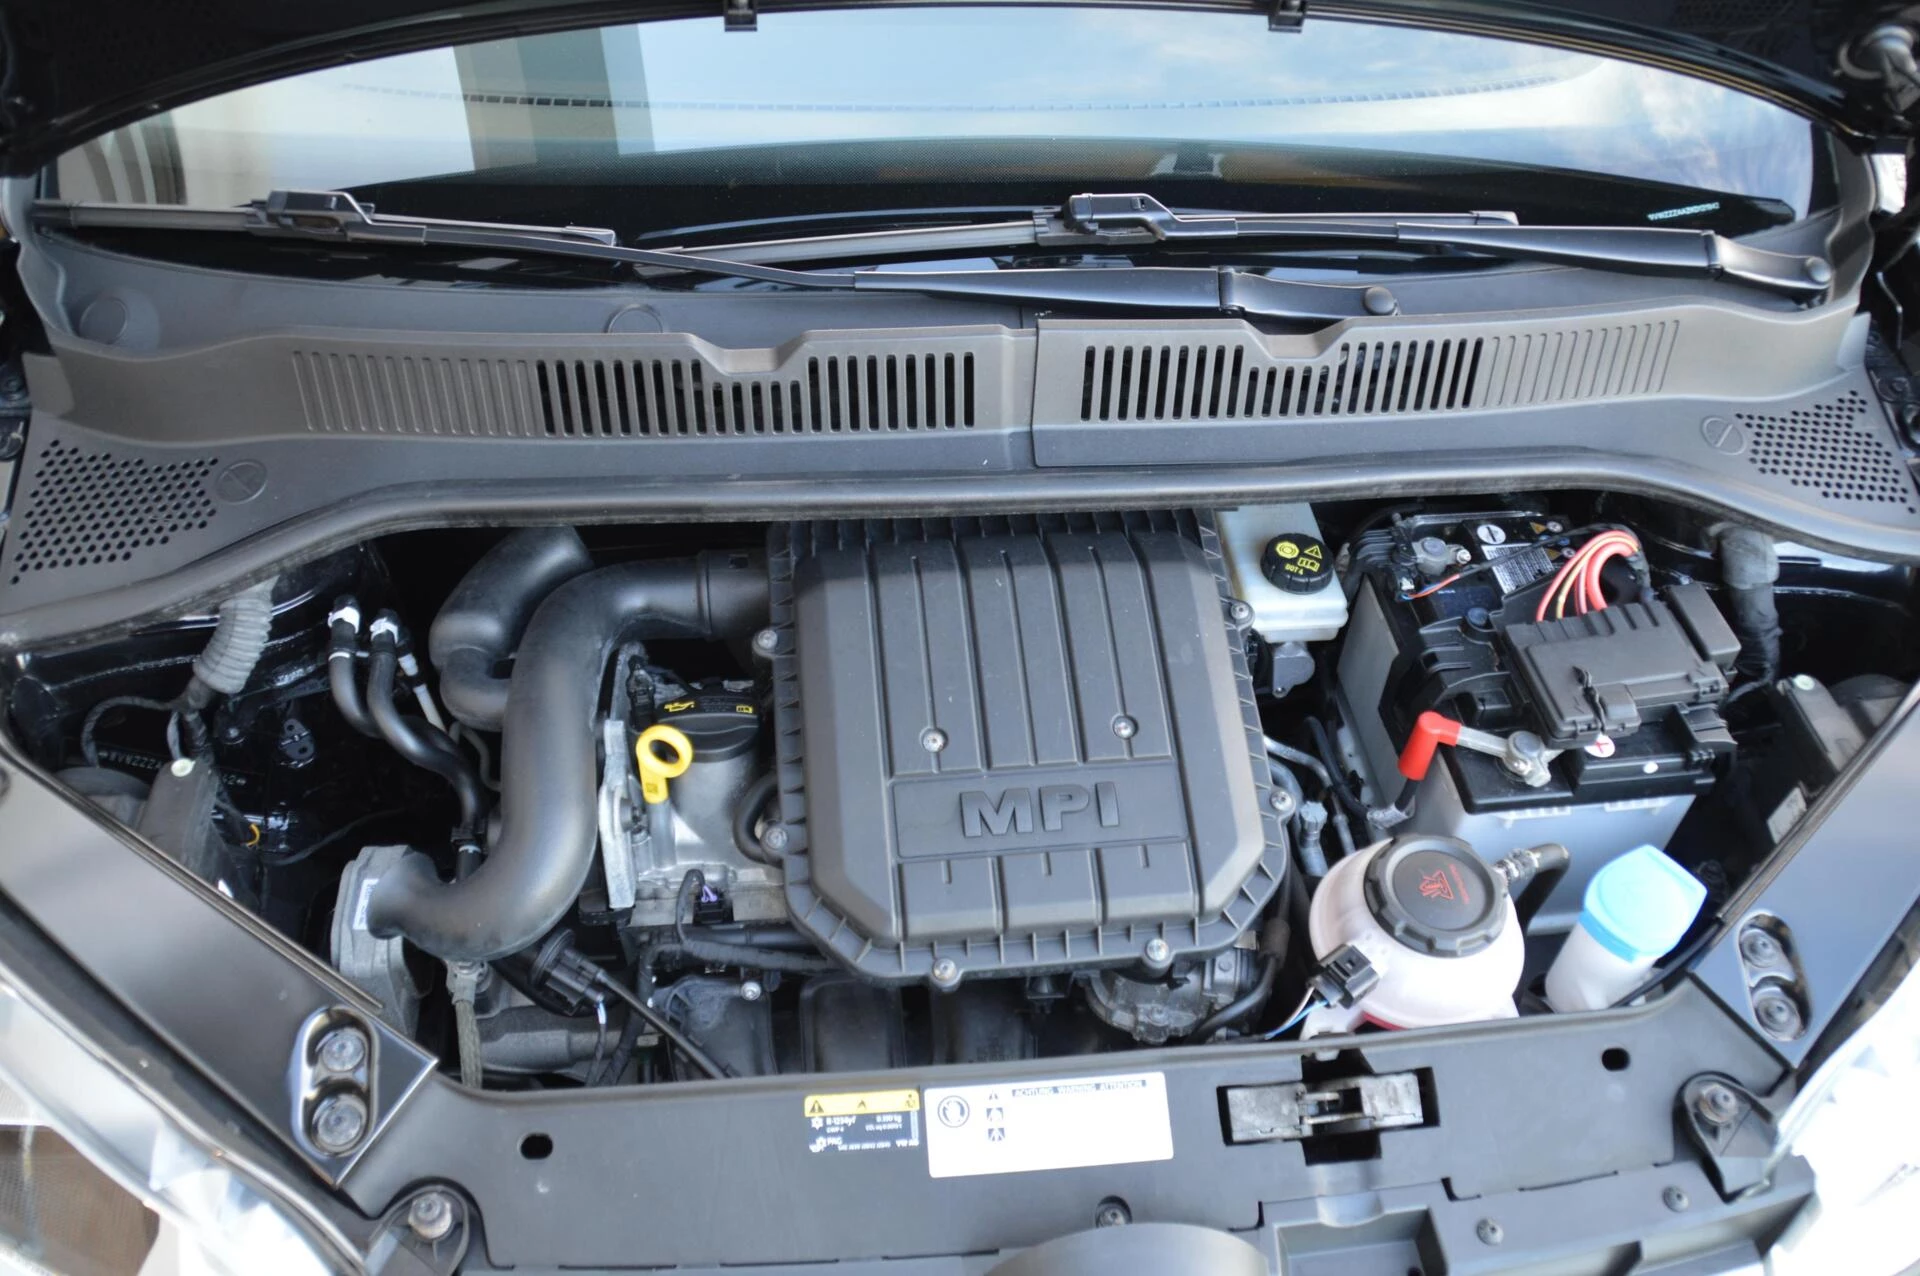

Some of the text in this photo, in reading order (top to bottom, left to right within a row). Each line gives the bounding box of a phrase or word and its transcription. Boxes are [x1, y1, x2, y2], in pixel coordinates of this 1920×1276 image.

[1285, 563, 1298, 573] DOT
[960, 781, 1119, 837] MPI
[1015, 1087, 1052, 1097] ACHTUNG
[1058, 1084, 1096, 1094] WARNING
